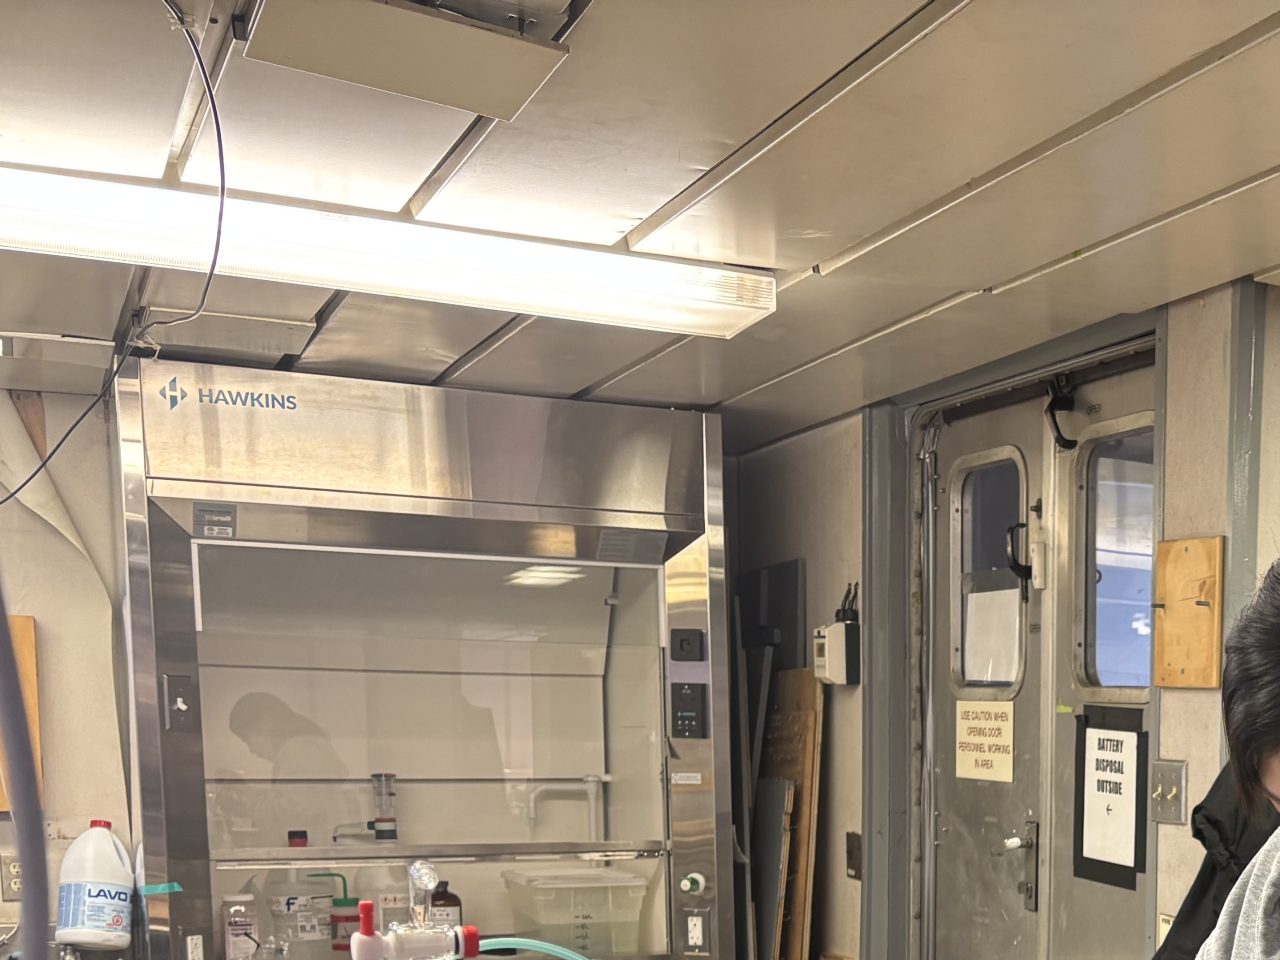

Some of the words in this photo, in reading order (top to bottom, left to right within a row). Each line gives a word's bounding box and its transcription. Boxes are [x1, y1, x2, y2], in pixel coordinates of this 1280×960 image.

[198, 387, 297, 410] HAWKINS
[1097, 737, 1124, 753] BATTERY
[1095, 758, 1125, 775] DISPOSAL
[1096, 778, 1123, 795] OUTSIDE
